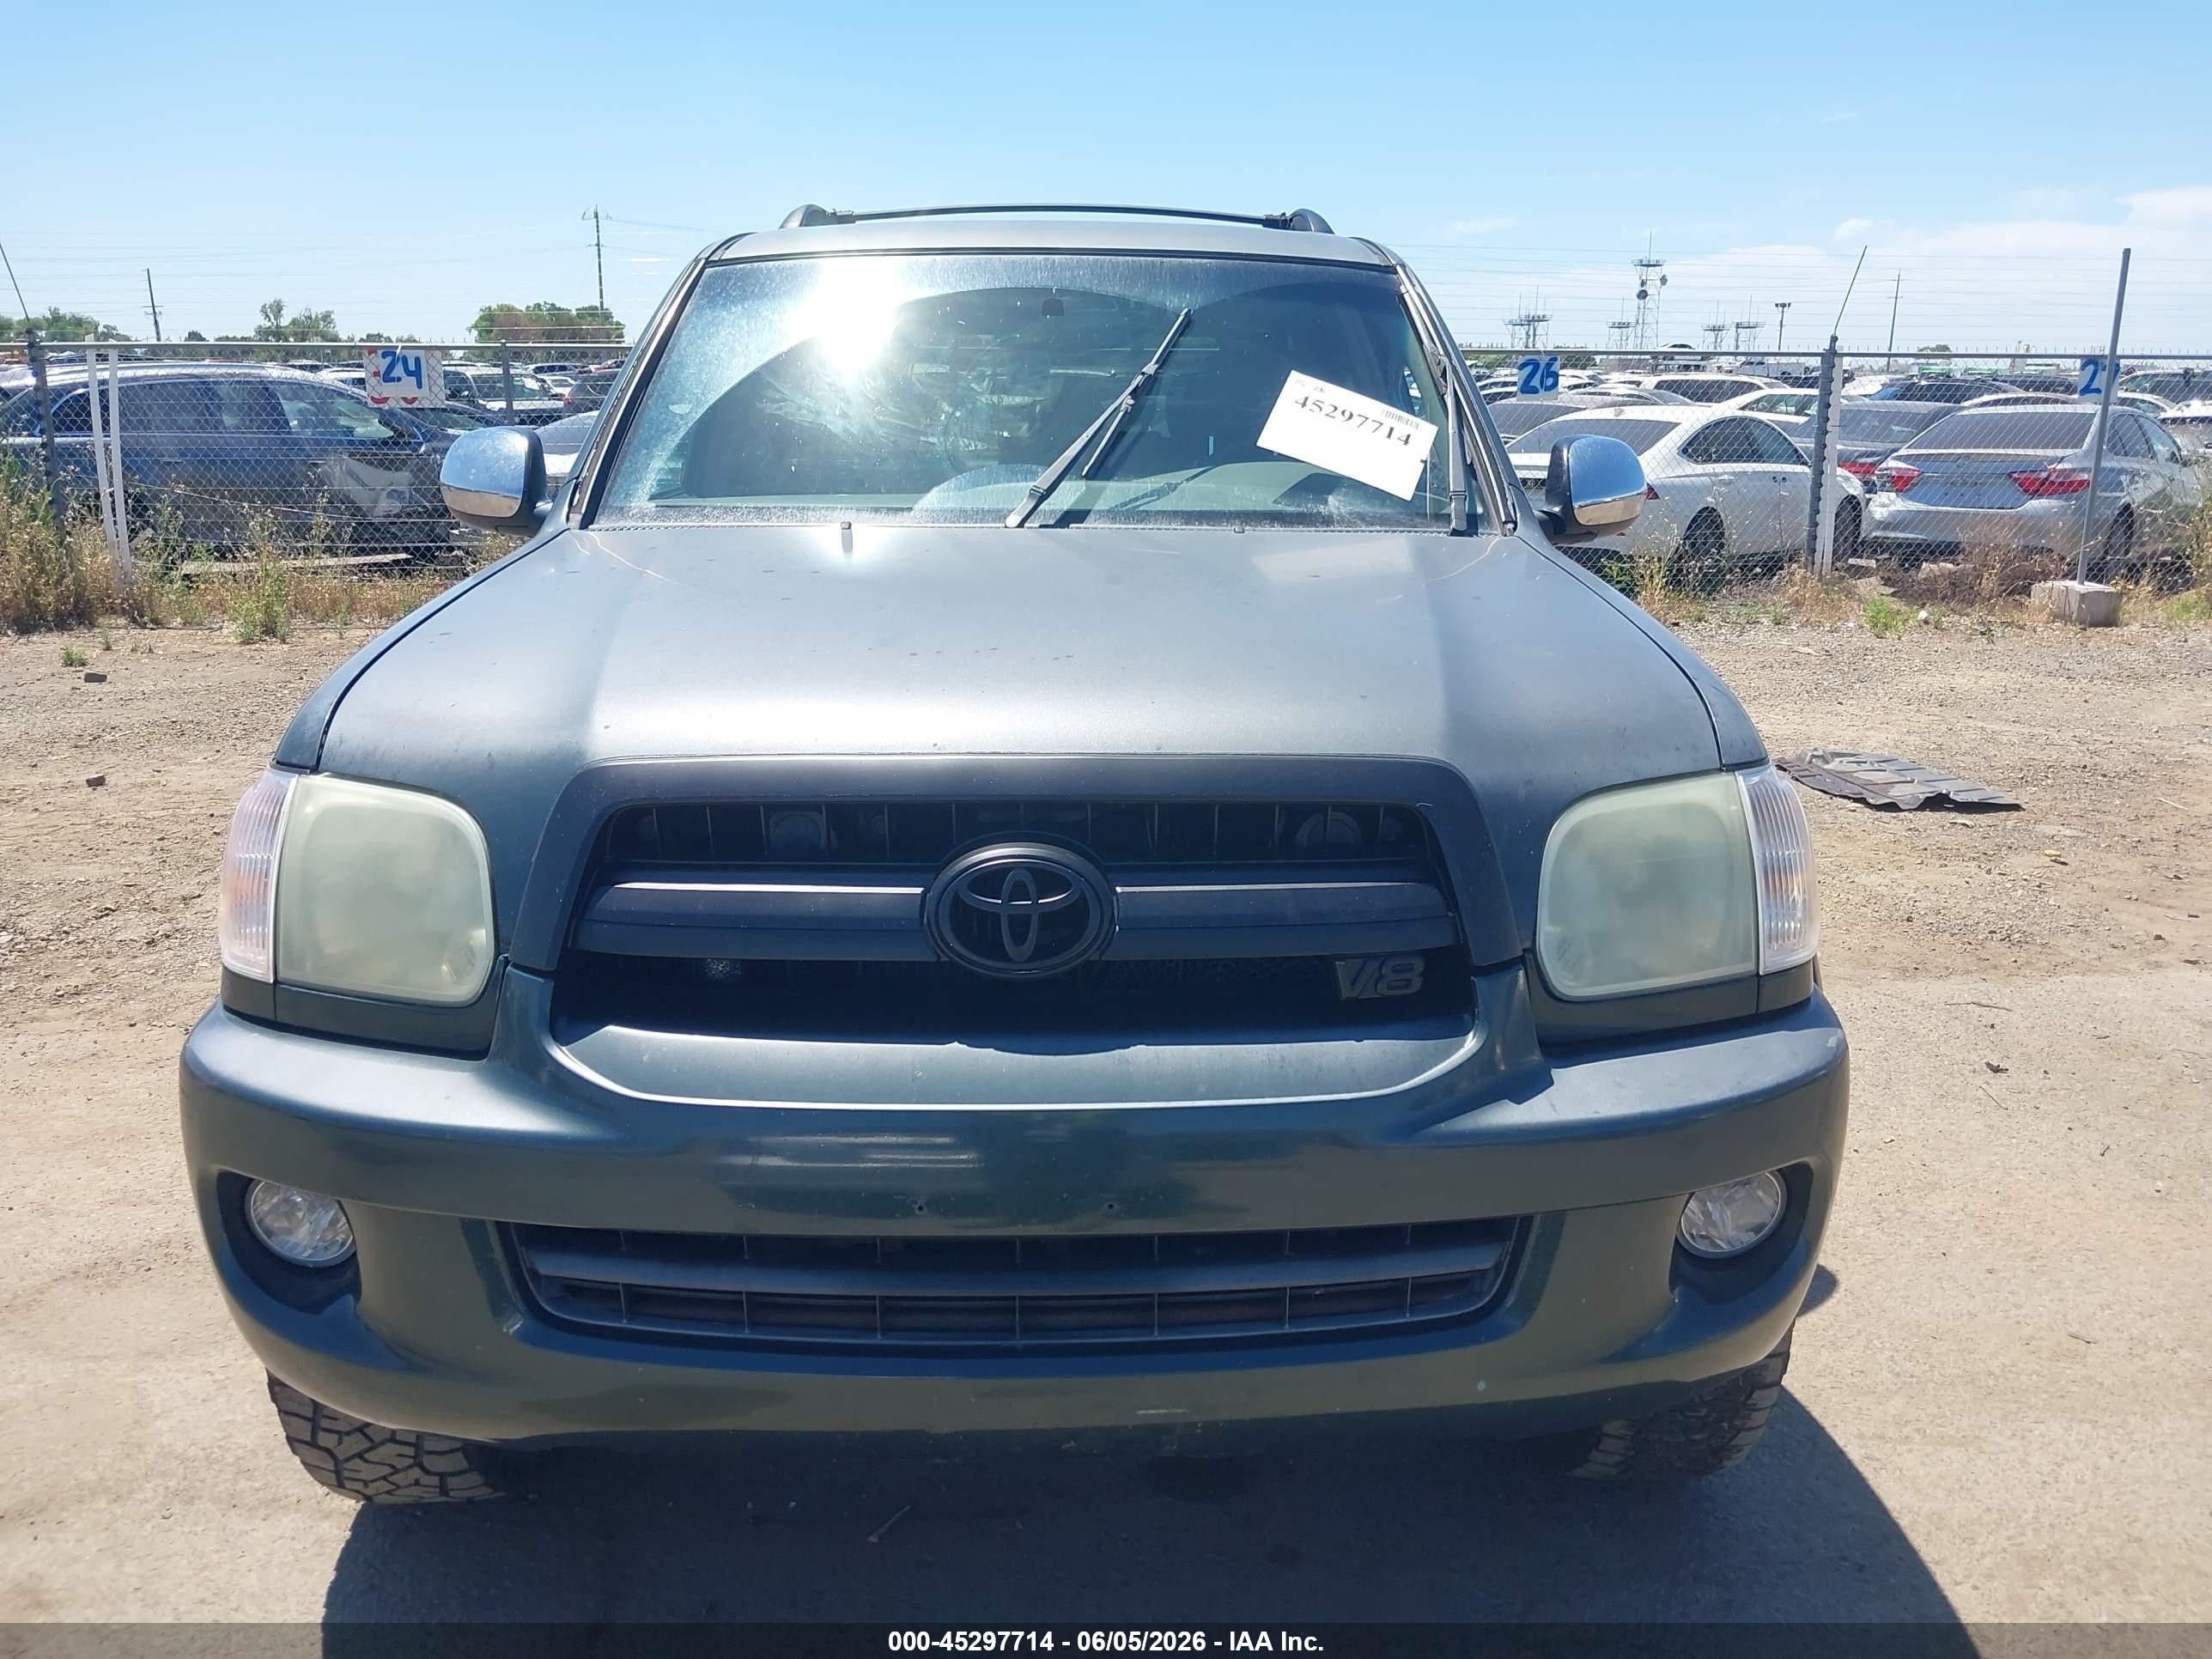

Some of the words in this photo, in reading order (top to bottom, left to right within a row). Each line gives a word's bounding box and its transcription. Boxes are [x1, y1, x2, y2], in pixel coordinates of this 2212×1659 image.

[381, 349, 422, 389] 24
[1518, 357, 1559, 394] 26
[1295, 396, 1411, 446] 45297714
[1334, 955, 1425, 1000] V8
